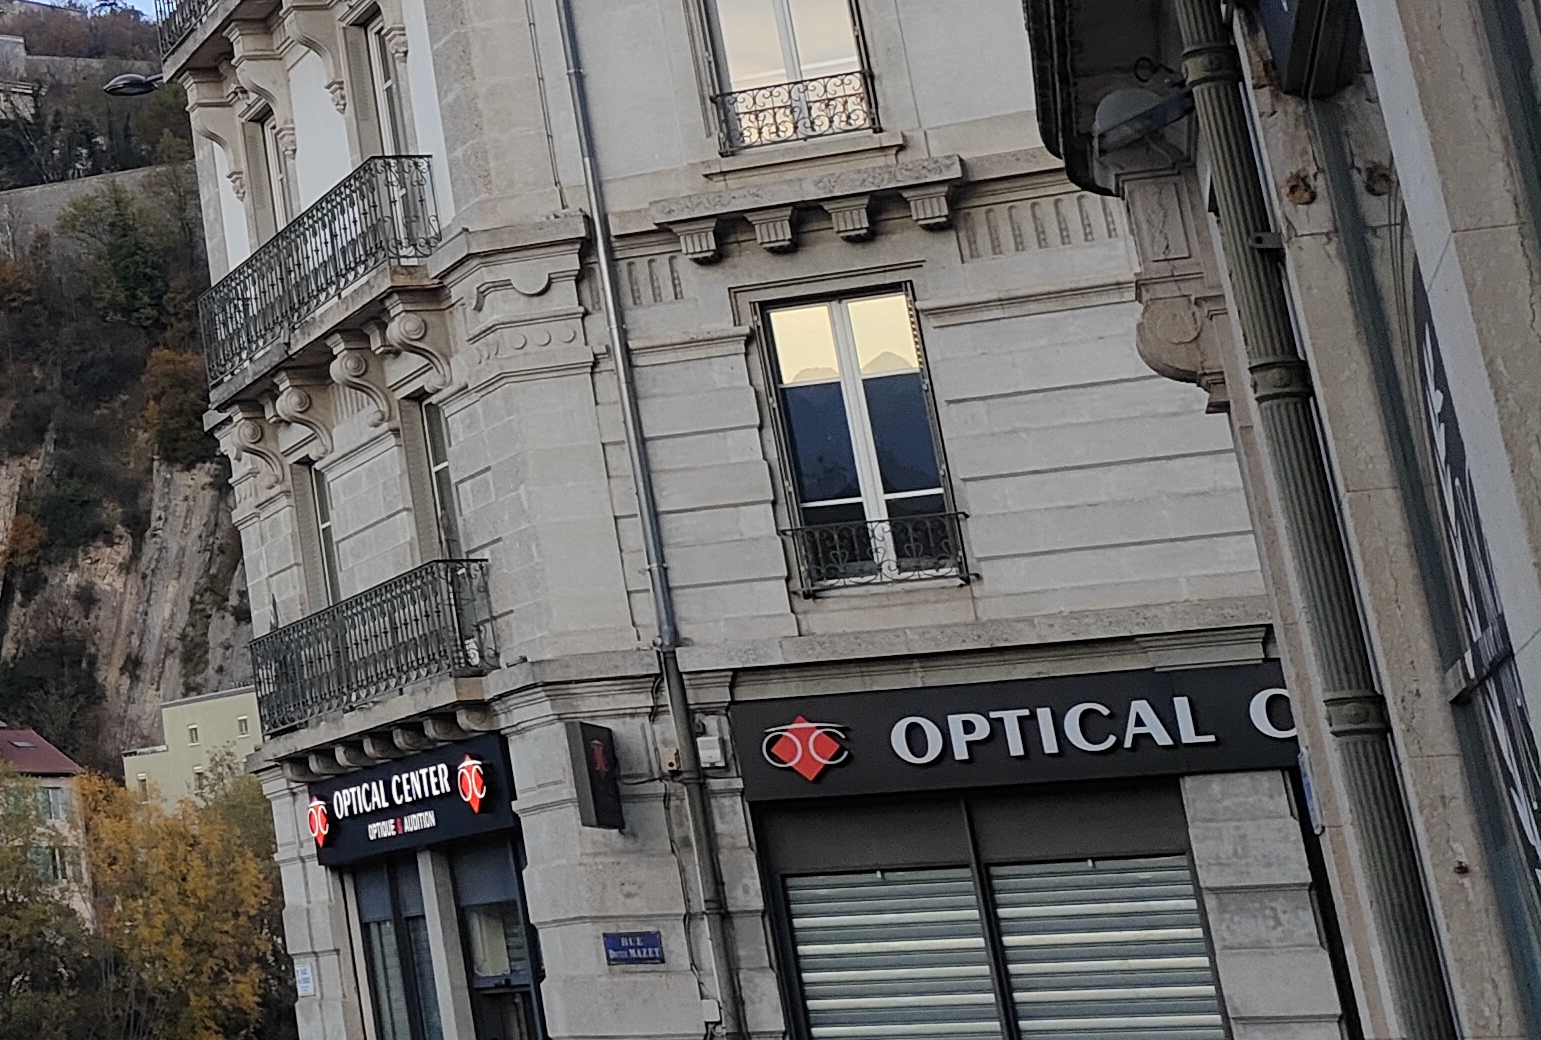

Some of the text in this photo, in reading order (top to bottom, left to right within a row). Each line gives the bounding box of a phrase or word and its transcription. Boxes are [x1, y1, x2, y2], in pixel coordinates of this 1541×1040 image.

[890, 696, 1216, 765] OPTICAL
[333, 763, 451, 820] OPTICAL CENTER
[368, 810, 436, 841] OPTIQUE AUDITION
[620, 937, 644, 947] RUE
